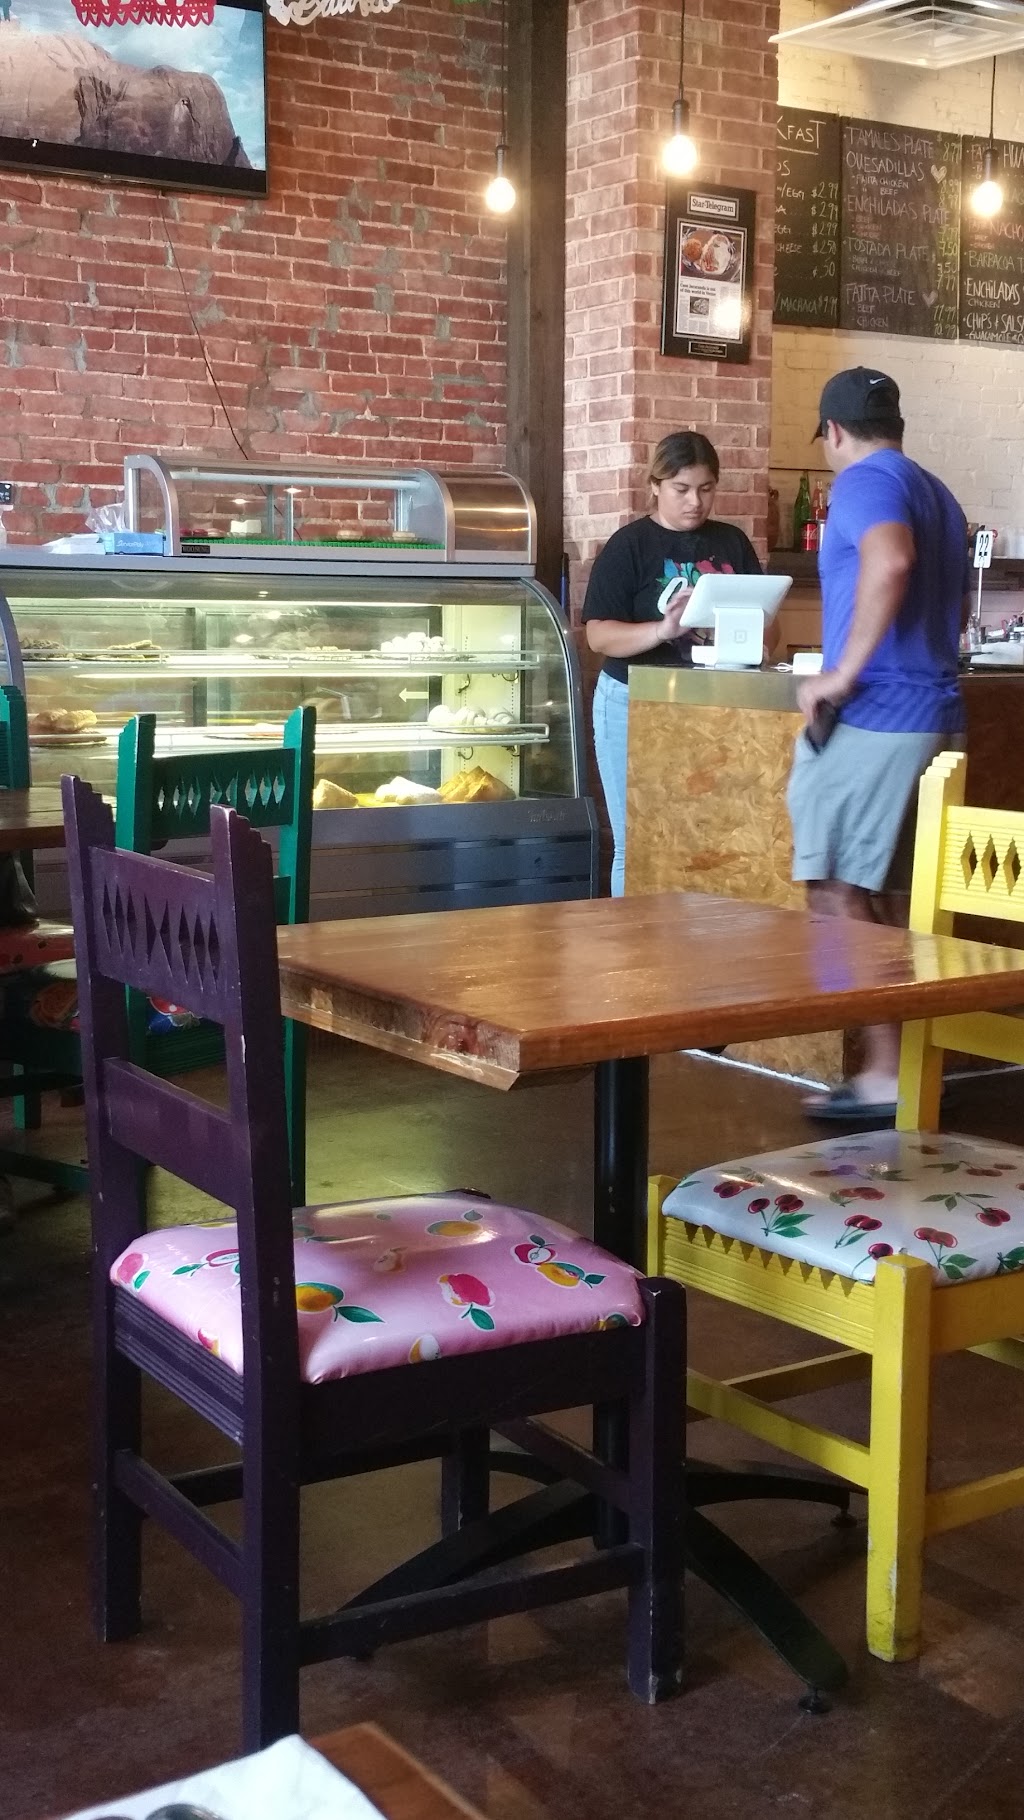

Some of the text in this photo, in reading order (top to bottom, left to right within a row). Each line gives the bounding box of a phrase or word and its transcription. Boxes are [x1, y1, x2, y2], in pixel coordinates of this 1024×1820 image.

[904, 134, 934, 159] PLATE
[879, 178, 909, 190] CHICKEN
[880, 187, 899, 197] BEEF
[847, 237, 891, 257] TOSTADA
[978, 534, 989, 557] 22
